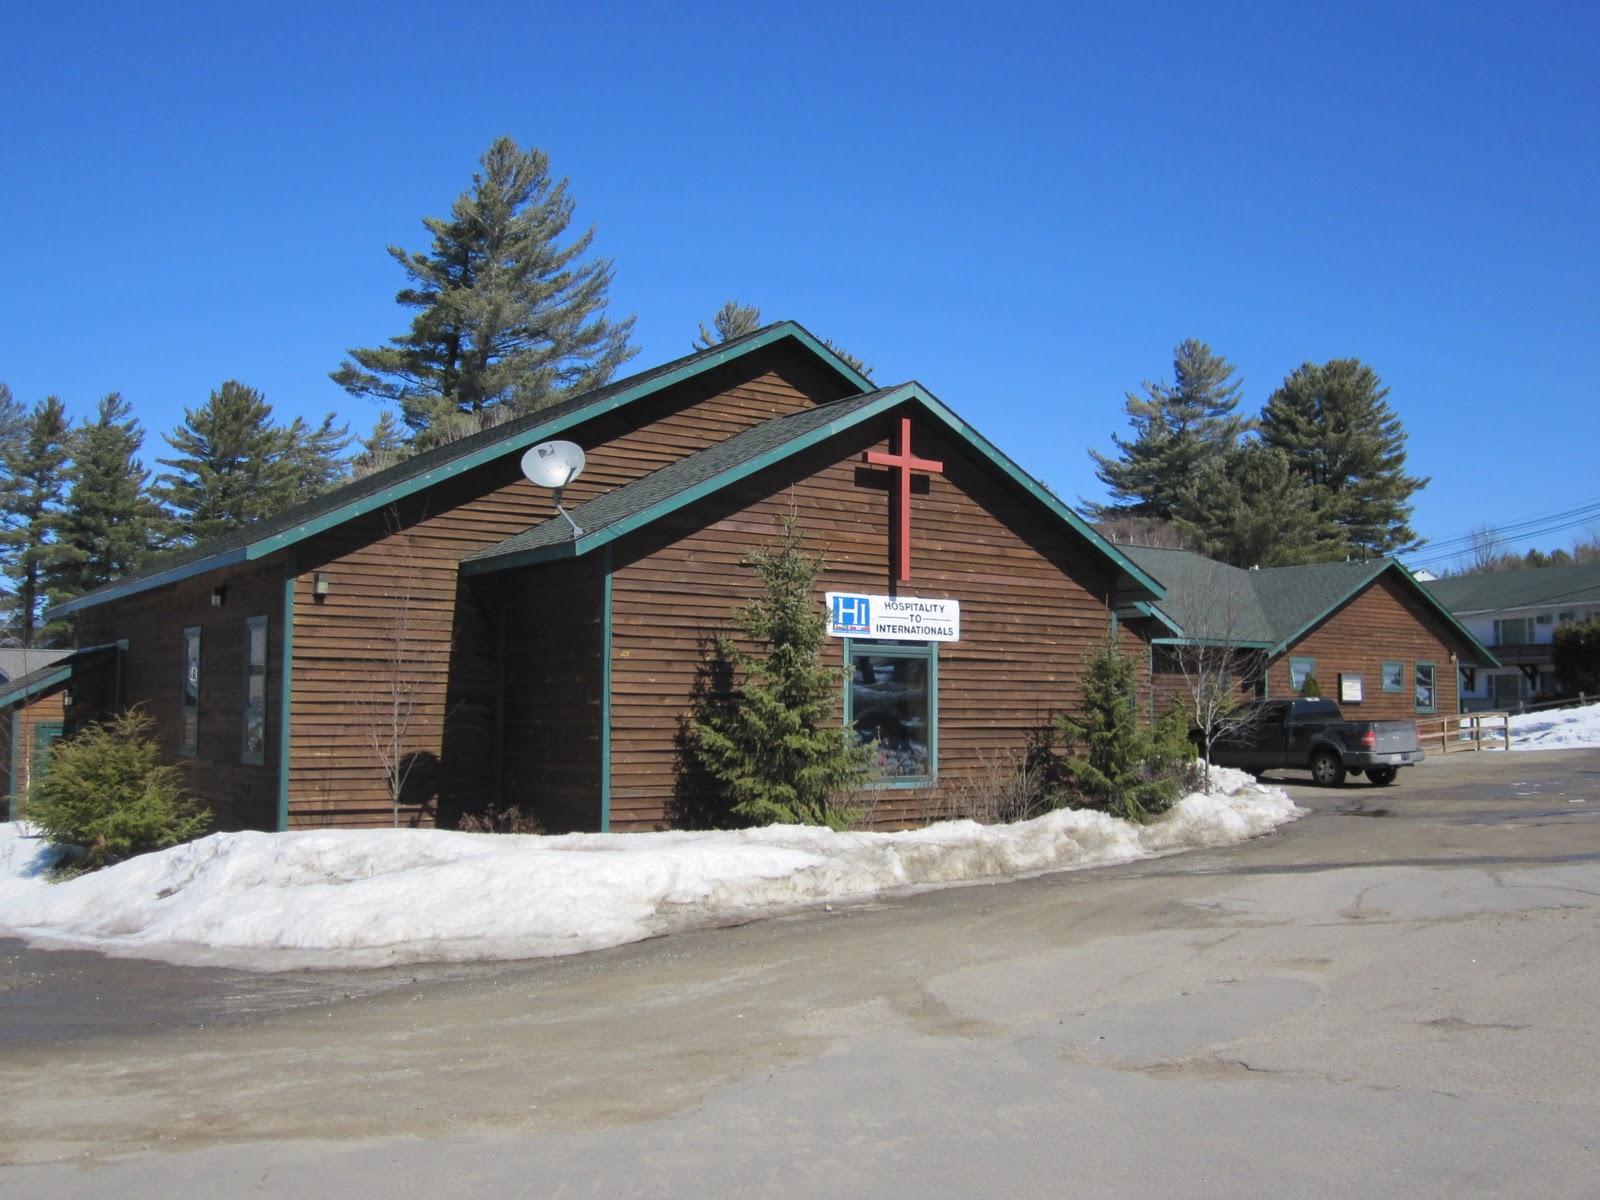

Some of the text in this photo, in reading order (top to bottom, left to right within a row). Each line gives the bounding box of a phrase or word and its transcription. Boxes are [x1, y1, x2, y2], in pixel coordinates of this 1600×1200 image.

[838, 598, 866, 625] HI
[884, 602, 945, 613] HOSPITALITY
[909, 614, 922, 623] TO
[876, 624, 953, 636] INTERNATIONALS
